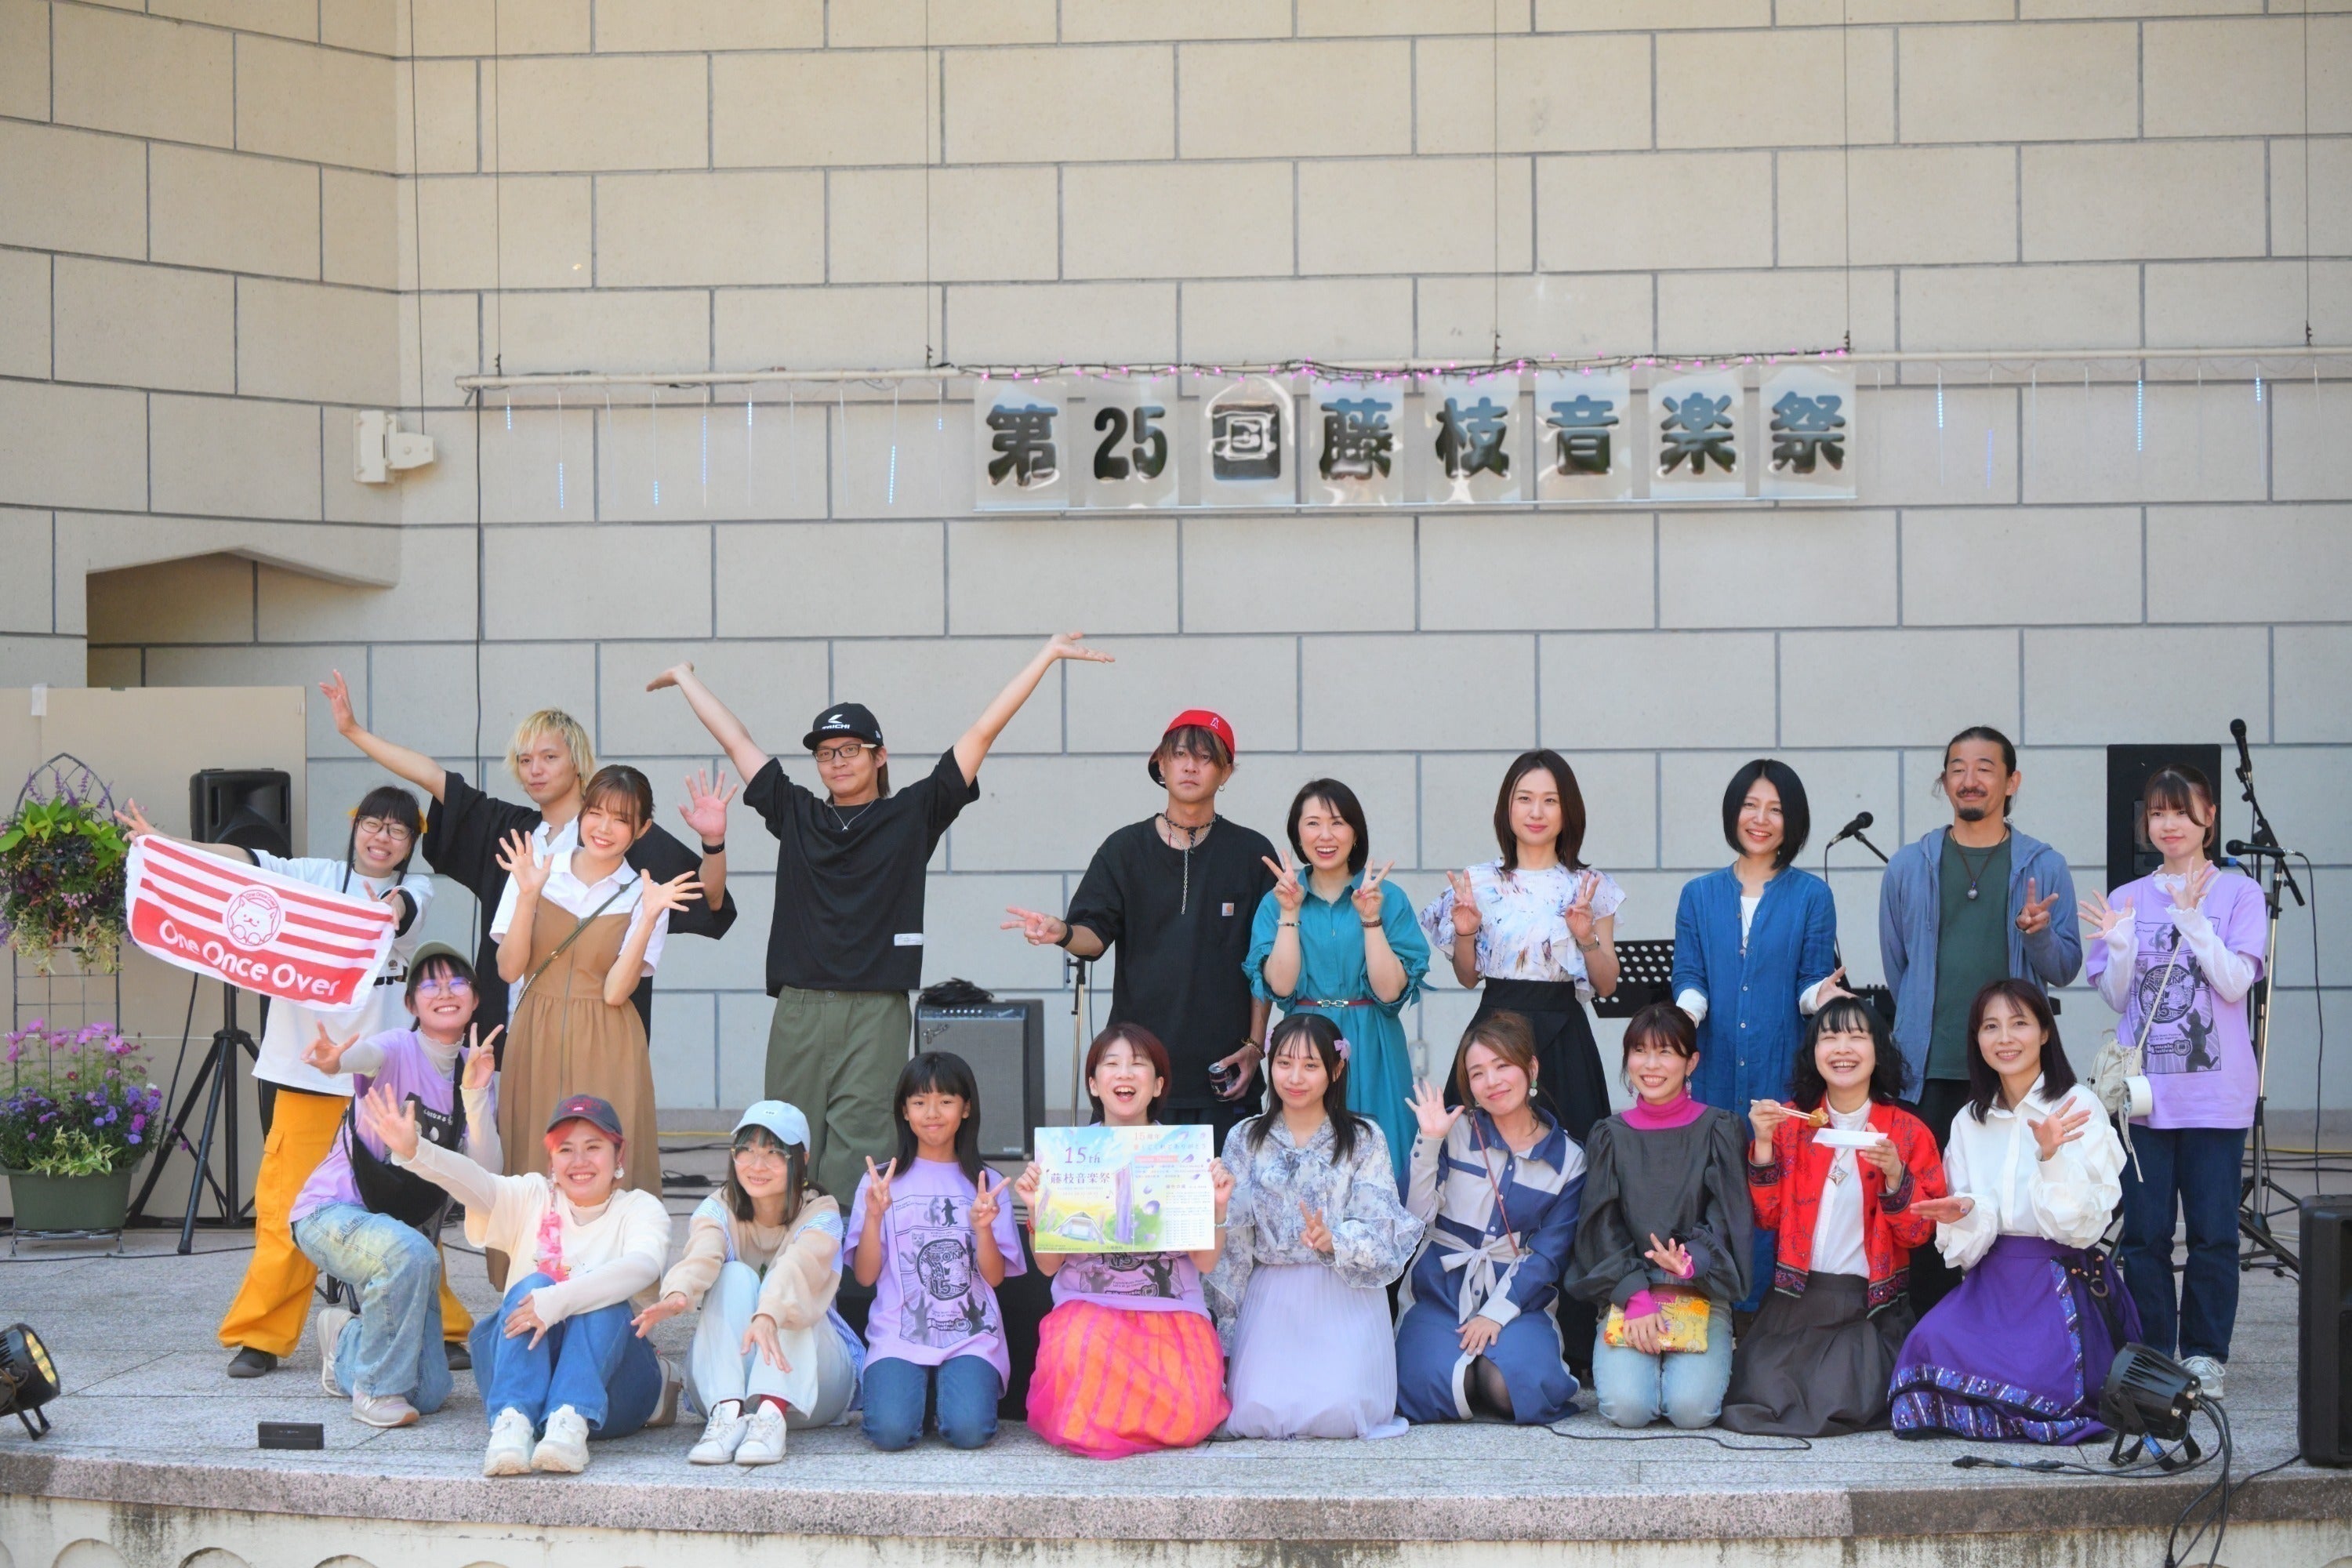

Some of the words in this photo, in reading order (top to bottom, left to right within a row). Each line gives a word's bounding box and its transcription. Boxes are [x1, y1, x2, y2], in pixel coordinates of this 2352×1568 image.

[985, 389, 1846, 486] 第25回藤枝音楽祭
[158, 919, 201, 955] One
[201, 940, 270, 982] Once
[271, 963, 341, 997] Over
[1051, 1172, 1110, 1185] 藤枝音楽祭
[1064, 1146, 1101, 1164] 15th
